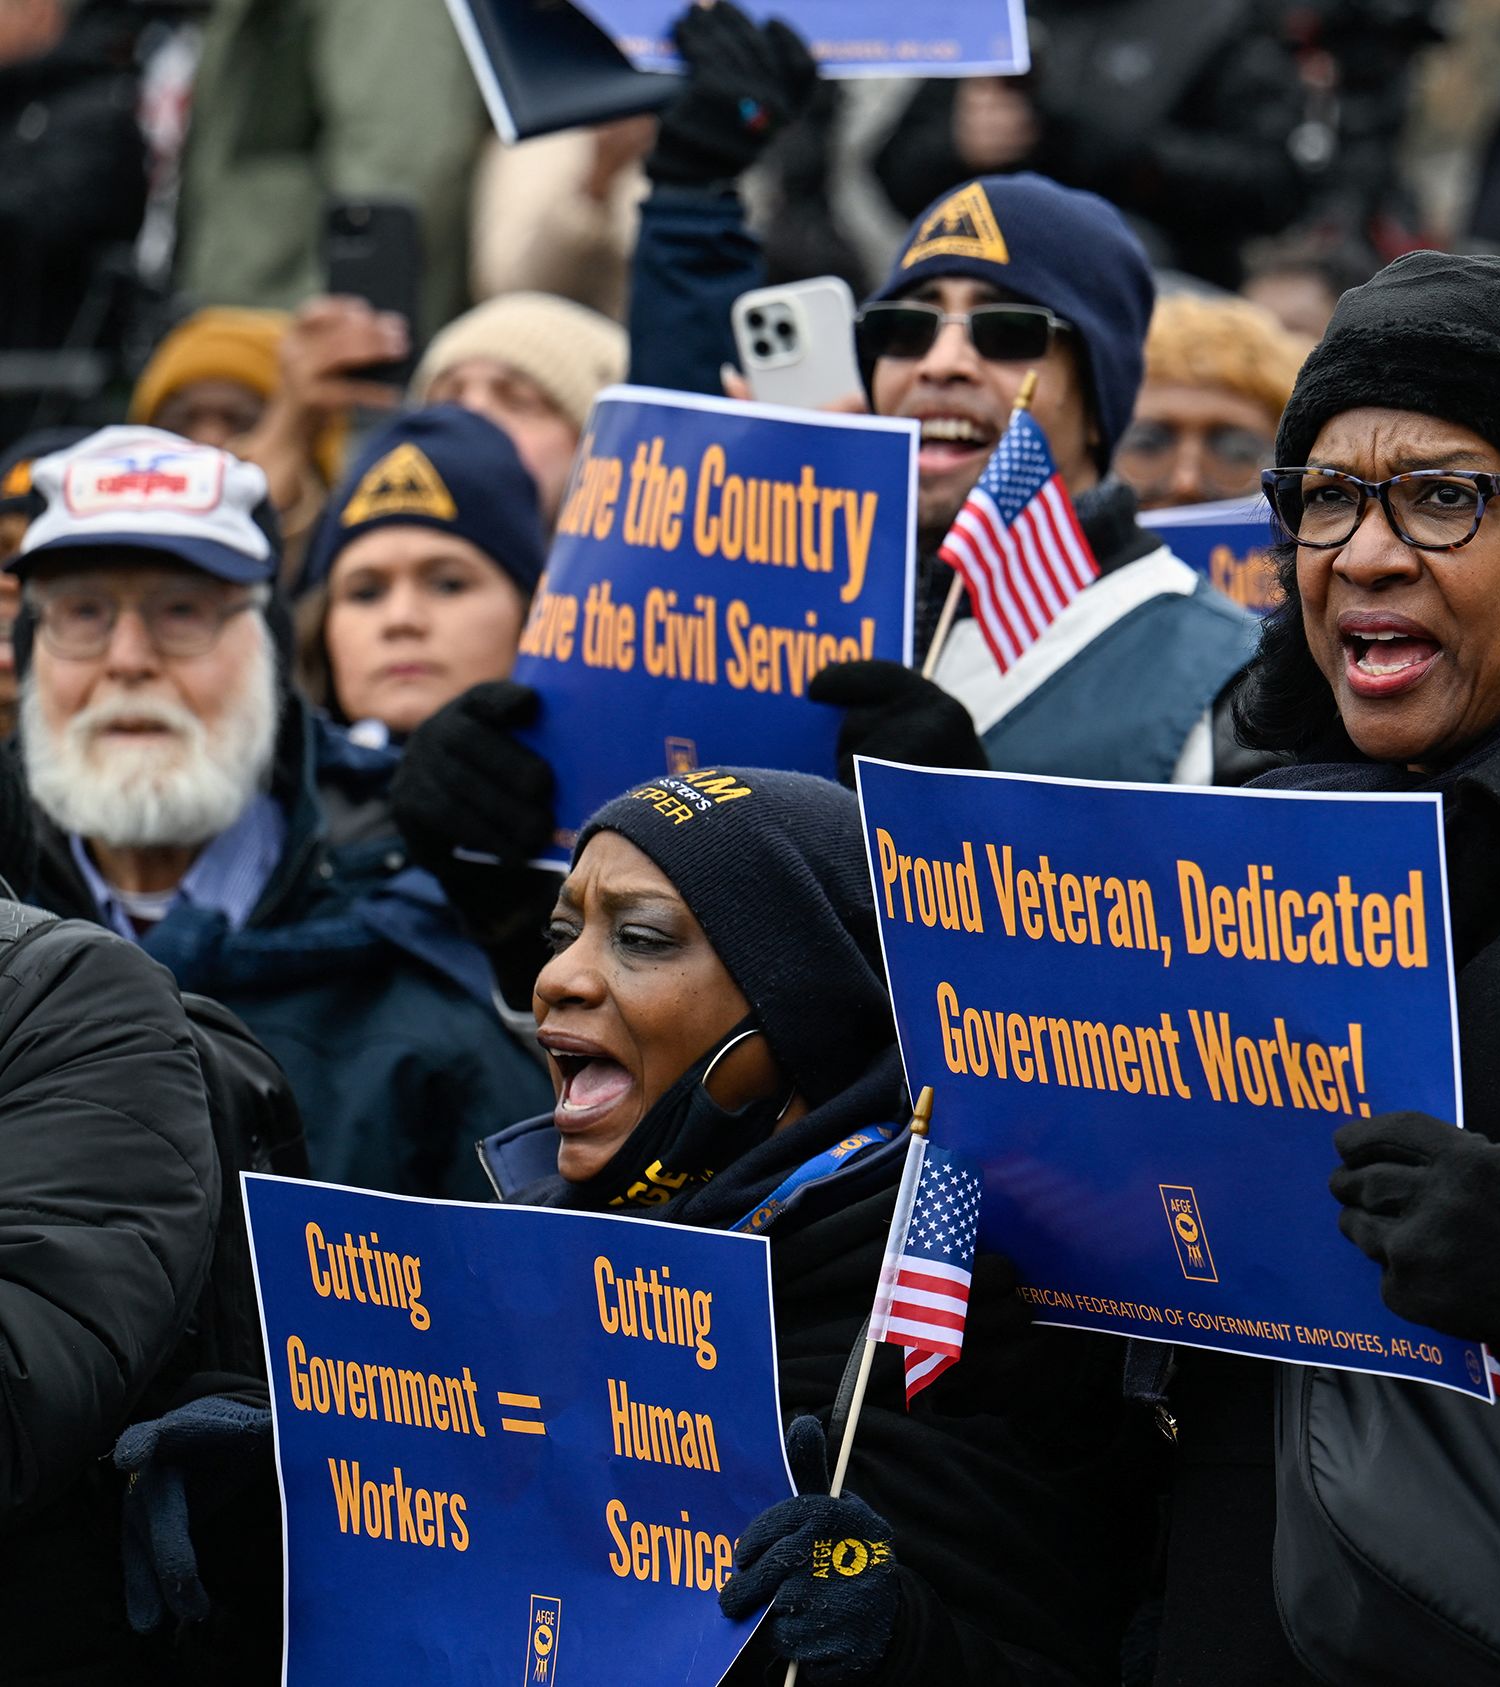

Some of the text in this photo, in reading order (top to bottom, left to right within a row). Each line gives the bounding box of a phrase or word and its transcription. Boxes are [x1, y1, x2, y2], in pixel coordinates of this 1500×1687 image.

[622, 437, 688, 551] the
[693, 444, 878, 604] Country
[582, 579, 636, 672] the
[643, 587, 717, 684] Civil
[632, 787, 695, 826] EPER
[876, 828, 1429, 968] Proud Veteran, Dedicated
[937, 981, 1371, 1120] Government Worker!
[1170, 1198, 1193, 1214] AFGE
[305, 1221, 431, 1331] Cutting
[593, 1255, 718, 1371] Cutting
[1015, 1287, 1444, 1366] ERICAN FEDERATION OF GOVERNMENT EMPLOYEES, AFL-CIO
[287, 1335, 486, 1437] Government
[607, 1378, 721, 1473] Human
[328, 1457, 470, 1553] Workers
[605, 1499, 740, 1592] Service
[812, 1538, 833, 1579] AFGE
[535, 1609, 555, 1626] AFGE
